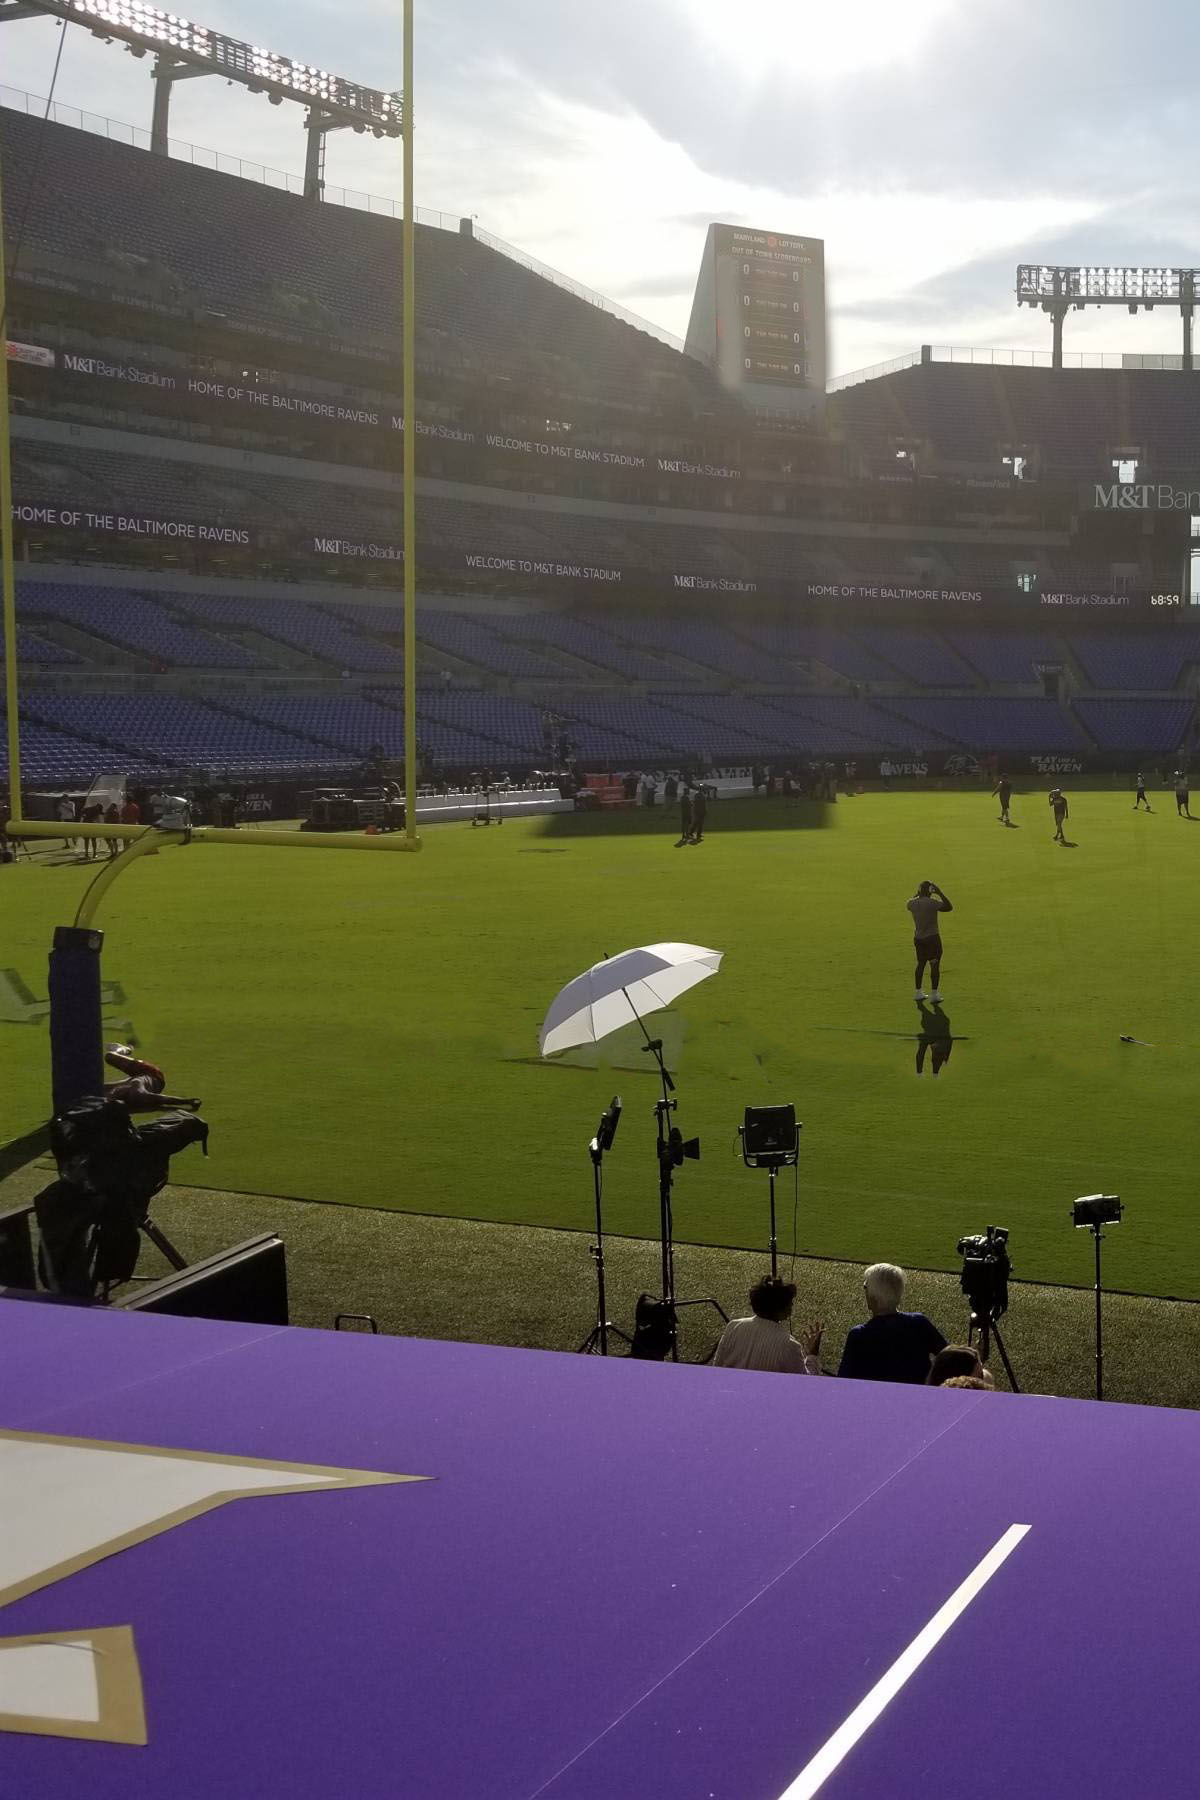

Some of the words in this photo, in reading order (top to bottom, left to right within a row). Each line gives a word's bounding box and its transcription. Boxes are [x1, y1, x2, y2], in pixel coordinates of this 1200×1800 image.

[731, 246, 744, 254] OUT
[745, 248, 754, 256] OF
[743, 264, 750, 275] 0
[792, 271, 799, 282] 0
[743, 295, 750, 306] 0
[793, 302, 799, 313] 0
[744, 326, 751, 337] 0
[793, 332, 800, 343] 0
[63, 353, 97, 374] M&T
[97, 359, 127, 380] Bank
[127, 366, 176, 389] Stadium
[745, 358, 751, 369] 0
[794, 364, 800, 375] 0
[188, 378, 225, 399] HOME
[228, 386, 246, 401] OF
[247, 389, 269, 406] THE
[272, 394, 336, 418] BALTIMORE
[338, 407, 379, 426] RAVENS
[415, 420, 439, 436] Bank
[439, 426, 475, 442] Stadium
[486, 433, 532, 453] WELCOME
[535, 443, 549, 455] TO
[551, 446, 572, 459] M&T
[574, 448, 602, 463] BANK
[603, 453, 645, 468] STADIUM
[657, 458, 681, 474] M&T
[681, 463, 705, 476] Bank
[705, 464, 742, 480] Stadium
[1094, 484, 1158, 509] M&T
[11, 505, 57, 524] HOME
[60, 510, 81, 526] OF
[85, 512, 114, 531] THE
[118, 516, 195, 539] BALTIMORE
[199, 526, 249, 544] RAVENS
[313, 537, 343, 553] M&T
[343, 540, 368, 557] Bank
[465, 555, 517, 571] WELCOME
[519, 560, 532, 572] TO
[534, 562, 554, 574] M&T
[556, 564, 582, 578] BANK
[583, 566, 621, 581] STADIUM
[673, 575, 697, 589] M&T
[697, 576, 718, 591] Bank
[718, 578, 757, 592] Stadium
[808, 584, 839, 596] HOME
[841, 585, 857, 597] OF
[858, 586, 879, 598] THE
[881, 587, 939, 601] BALTIMORE
[941, 590, 982, 602] RAVENS
[1040, 592, 1065, 605] M&T
[1065, 594, 1090, 606] Bank
[1090, 594, 1129, 606] Stadium
